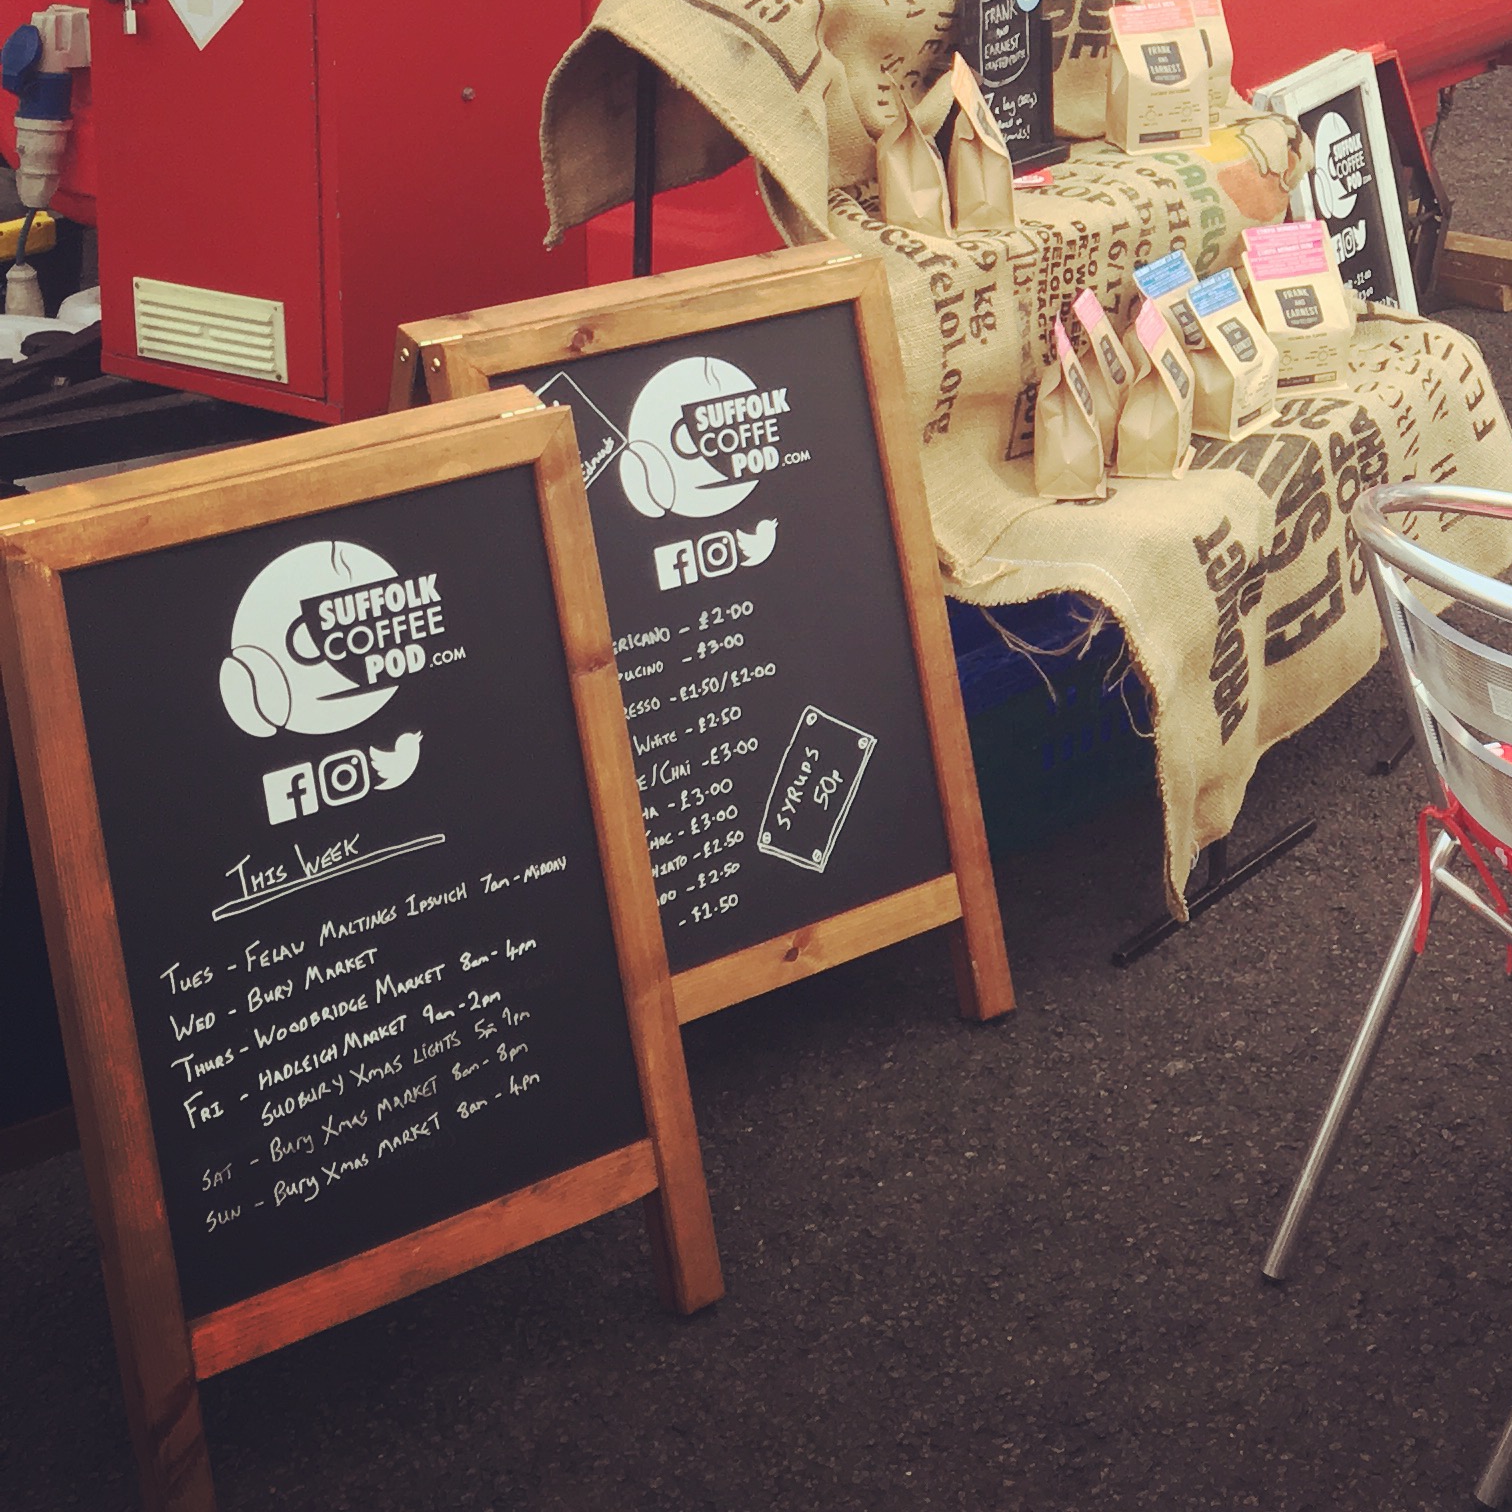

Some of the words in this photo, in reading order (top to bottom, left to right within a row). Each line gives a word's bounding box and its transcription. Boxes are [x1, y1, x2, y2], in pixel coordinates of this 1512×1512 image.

[984, 0, 1018, 31] FRANK
[984, 32, 1021, 60] EARNEST
[1148, 45, 1172, 55] FRANK
[1150, 64, 1182, 74] EARNEST
[1333, 133, 1364, 161] SUFFOLK
[1336, 150, 1365, 178] COFFEE
[1347, 171, 1363, 192] POD
[1283, 289, 1309, 299] FRANK
[1286, 306, 1318, 318] EARNEST
[695, 388, 791, 432] SUFFOLK
[700, 418, 780, 458] COFFE
[731, 445, 780, 479] POD
[318, 573, 442, 631] SUFFOLK
[698, 600, 754, 630] £2.00
[1264, 547, 1346, 666] EL
[323, 606, 446, 661] COFFEE
[697, 633, 745, 659] £3.00
[1193, 515, 1249, 746] PRODUCT
[364, 643, 426, 685] POD
[698, 706, 743, 735] £2.50
[709, 737, 759, 767] £3.00
[680, 778, 734, 811] £3.00
[689, 804, 739, 836] £3.00
[703, 829, 745, 859] £2.50
[224, 854, 288, 900] THIS
[294, 833, 360, 879] WEEK
[698, 860, 741, 891] £2.50
[691, 893, 739, 925] £1.50
[159, 962, 214, 995] TUES
[319, 905, 398, 947] MALTINGS
[169, 1011, 215, 1042] WED
[304, 947, 378, 990] MARKET
[254, 994, 369, 1050] WOODBRIDGE
[375, 964, 446, 1004] MARKET
[183, 1090, 225, 1130] FRI
[258, 1043, 338, 1091] HADLEIGH
[343, 1014, 407, 1057] MARKET
